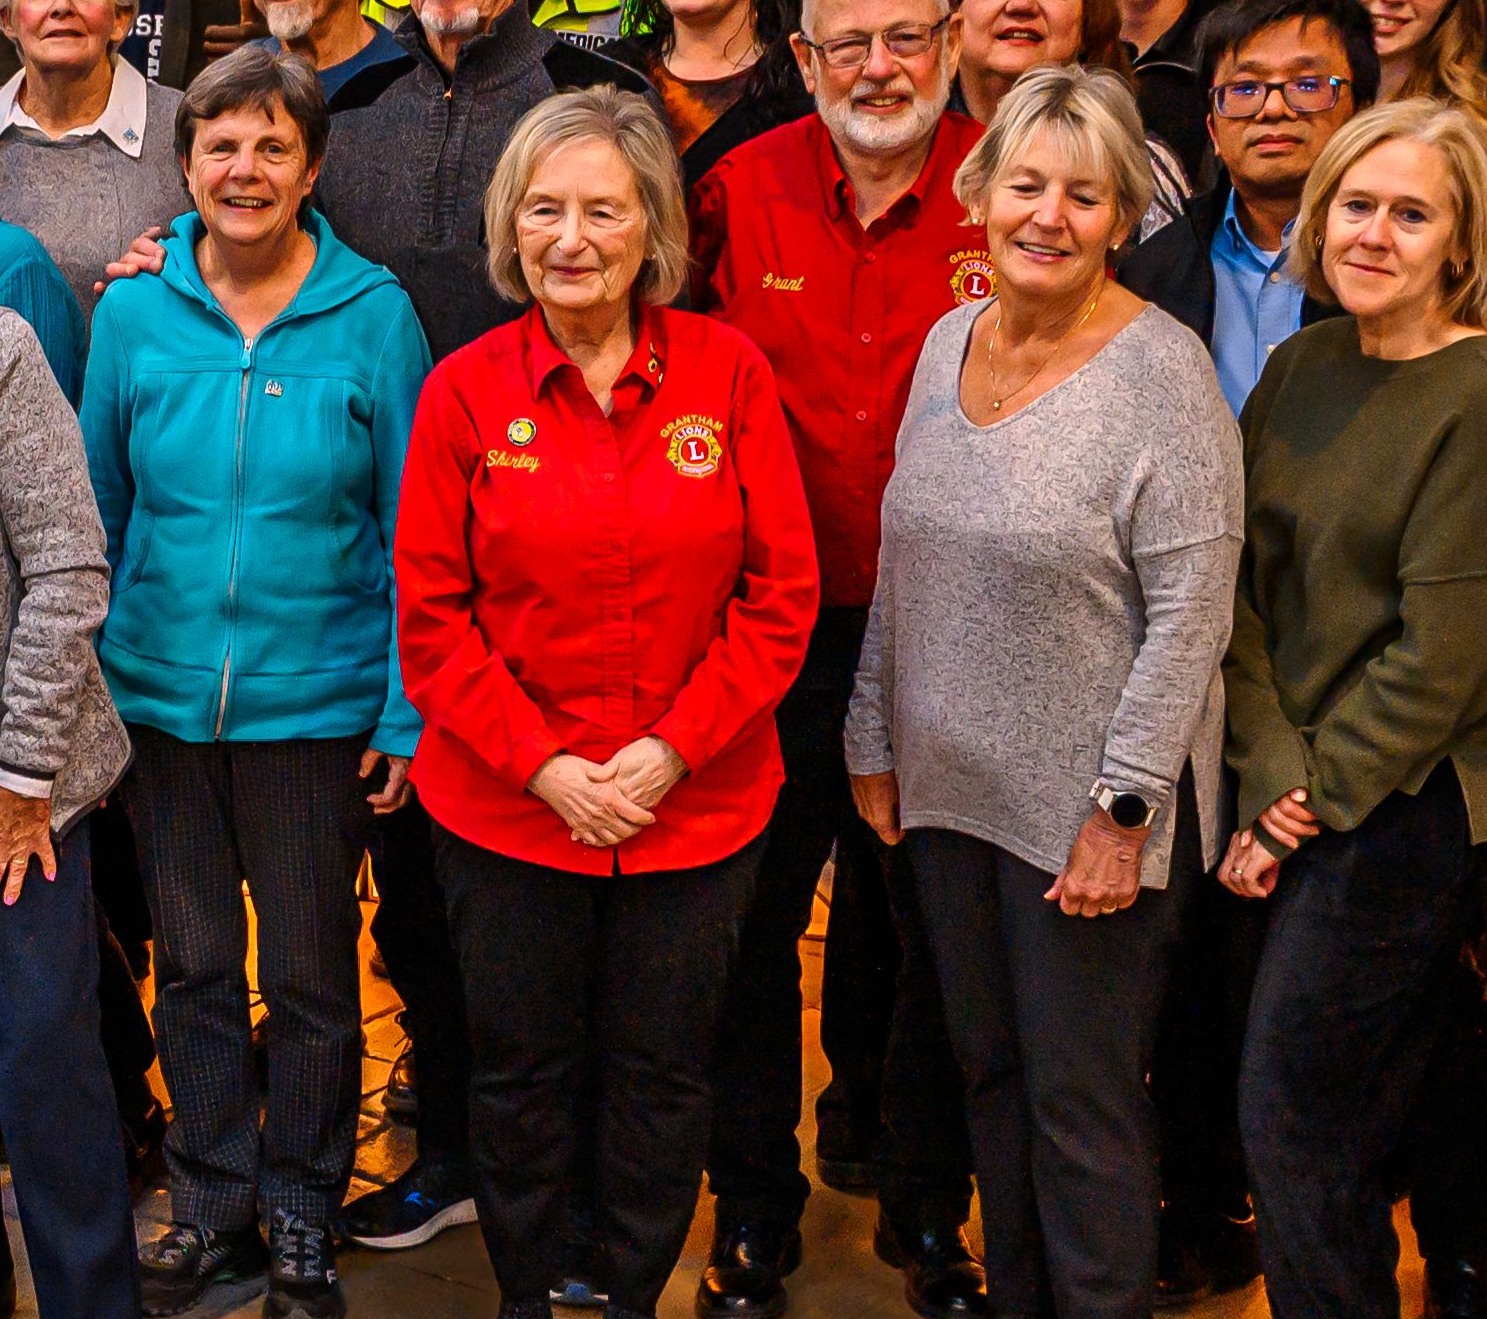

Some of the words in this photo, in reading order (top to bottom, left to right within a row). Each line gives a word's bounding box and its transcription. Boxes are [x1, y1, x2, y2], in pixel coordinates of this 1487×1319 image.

[969, 275, 985, 296] L
[660, 414, 724, 438] GRANTHAM
[486, 449, 540, 473] Shirley
[687, 440, 705, 461] L
